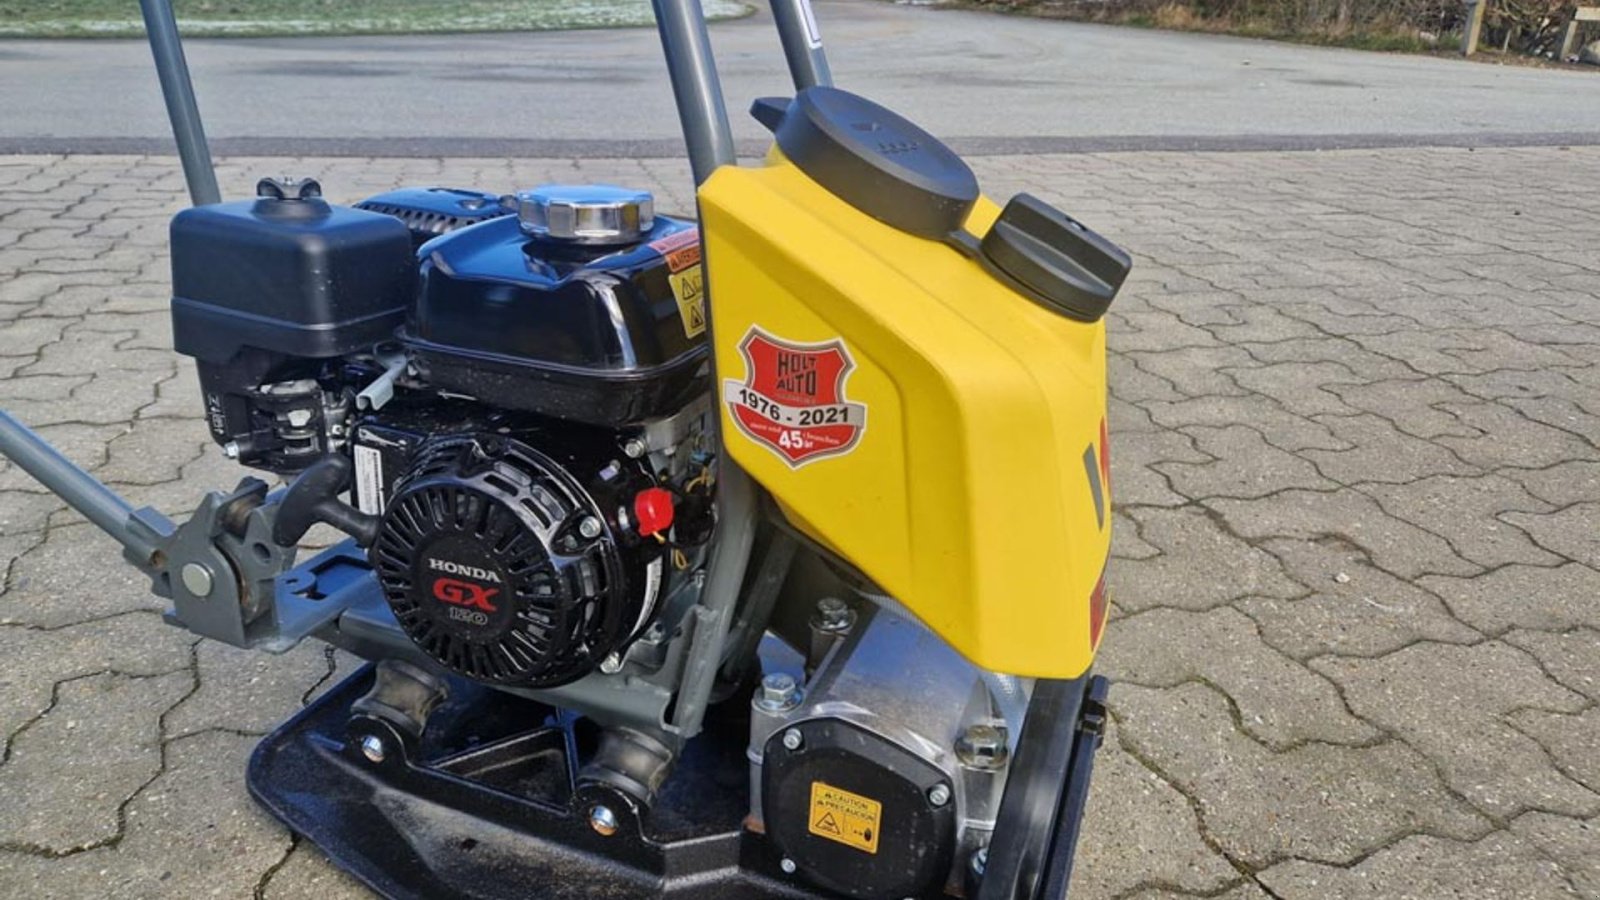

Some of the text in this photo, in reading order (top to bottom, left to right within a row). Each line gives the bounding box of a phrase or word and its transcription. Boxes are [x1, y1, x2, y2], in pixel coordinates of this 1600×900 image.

[777, 352, 817, 377] HOLT
[776, 371, 816, 396] AUTO
[739, 388, 780, 421] 1976
[799, 406, 849, 426] 2021
[779, 430, 803, 449] 45
[429, 558, 502, 583] HONDA
[433, 577, 499, 613] GX
[449, 606, 489, 625] 120
[833, 794, 868, 810] CAUTION
